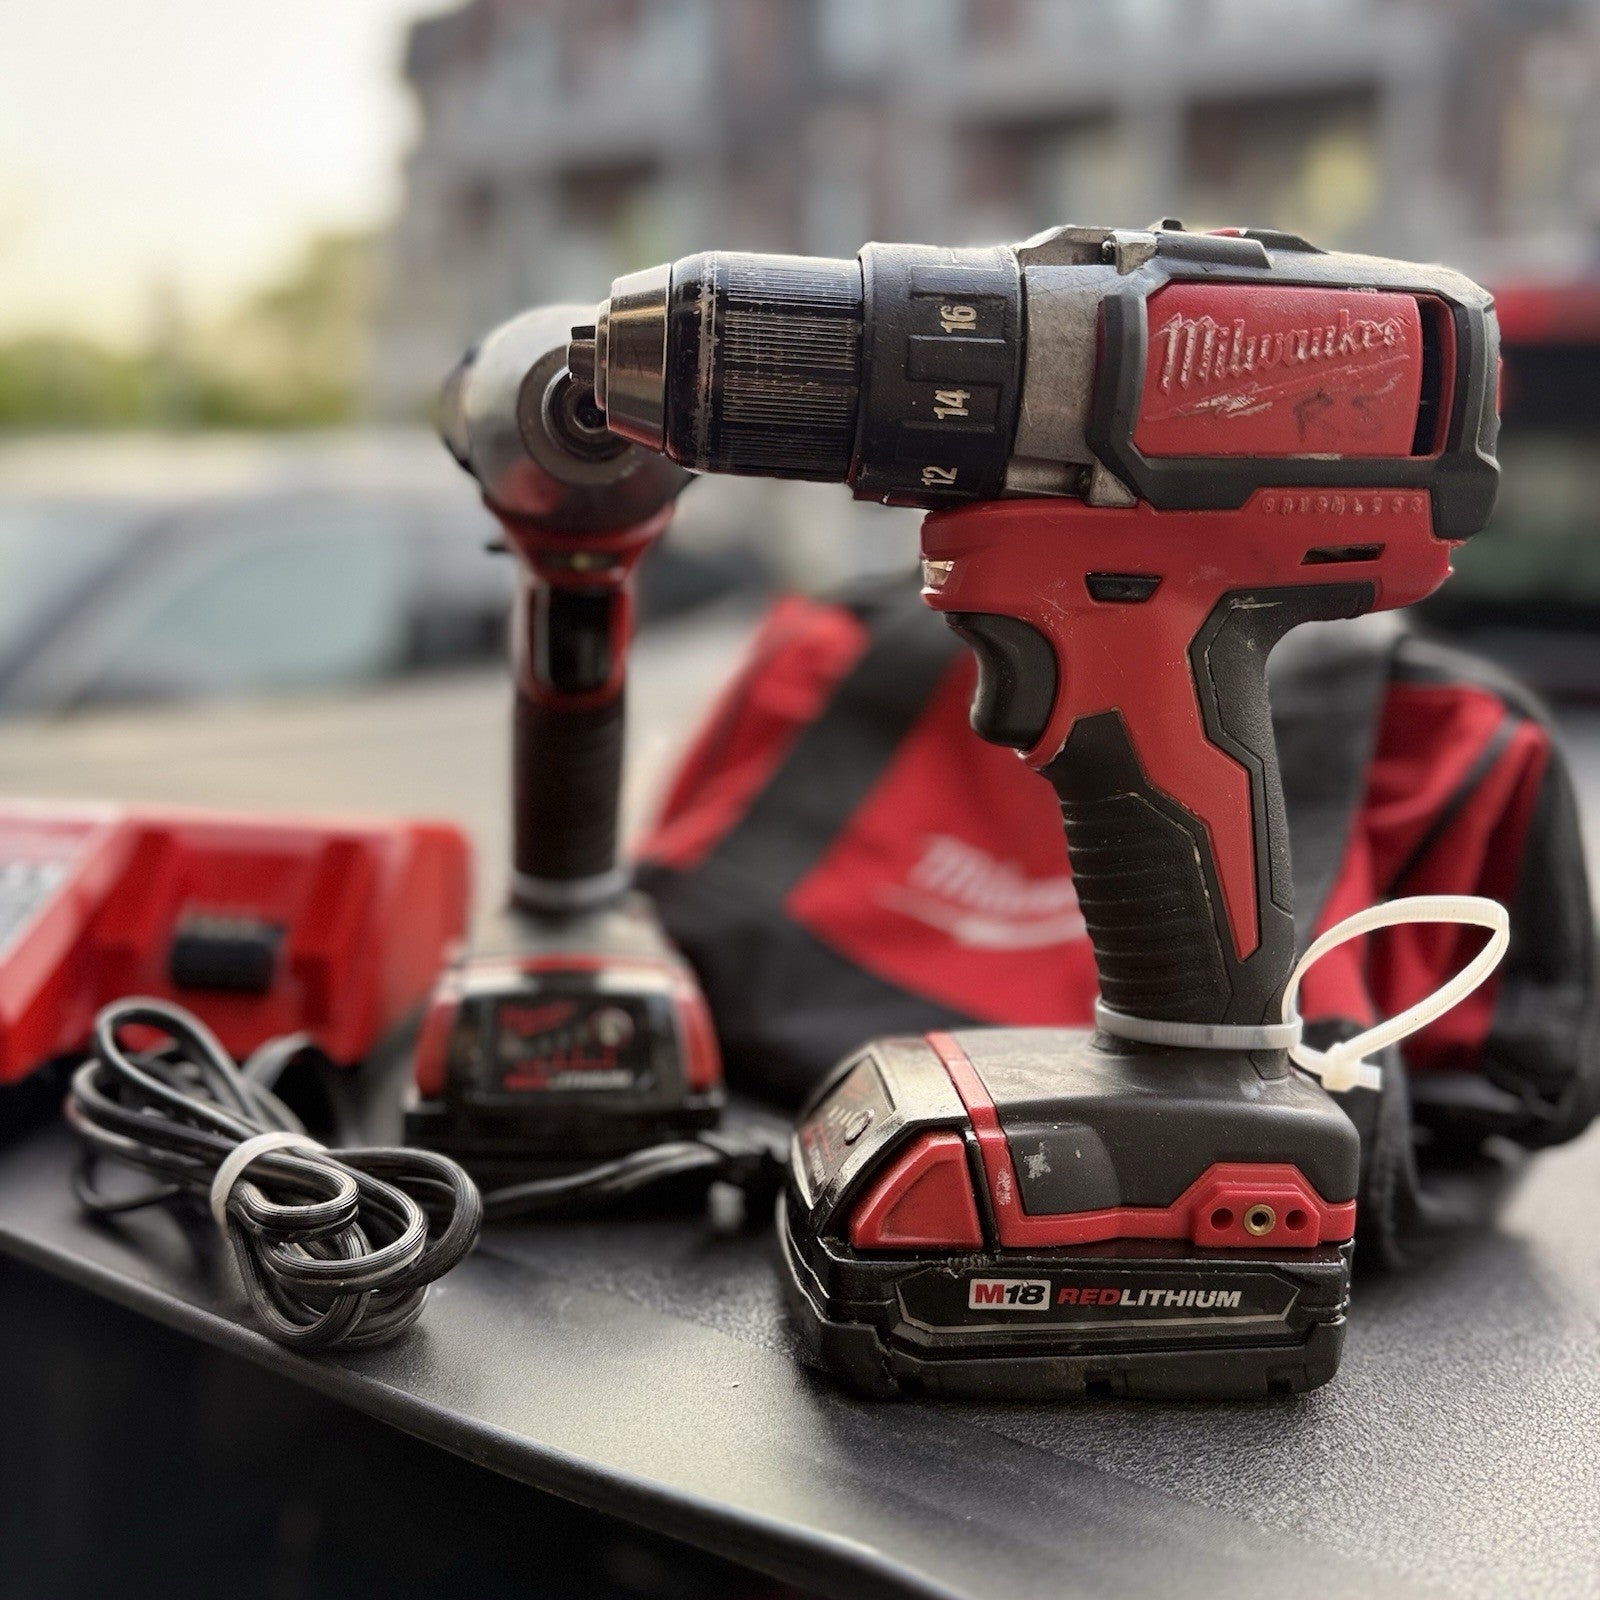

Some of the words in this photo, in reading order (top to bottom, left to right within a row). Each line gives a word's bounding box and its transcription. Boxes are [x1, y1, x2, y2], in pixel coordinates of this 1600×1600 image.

[940, 304, 978, 334] 16
[1154, 308, 1411, 395] Milwaukee
[932, 388, 971, 420] 14
[920, 465, 958, 486] 12
[973, 1282, 1047, 1306] M18
[1056, 1286, 1243, 1309] REDLITHIUM
